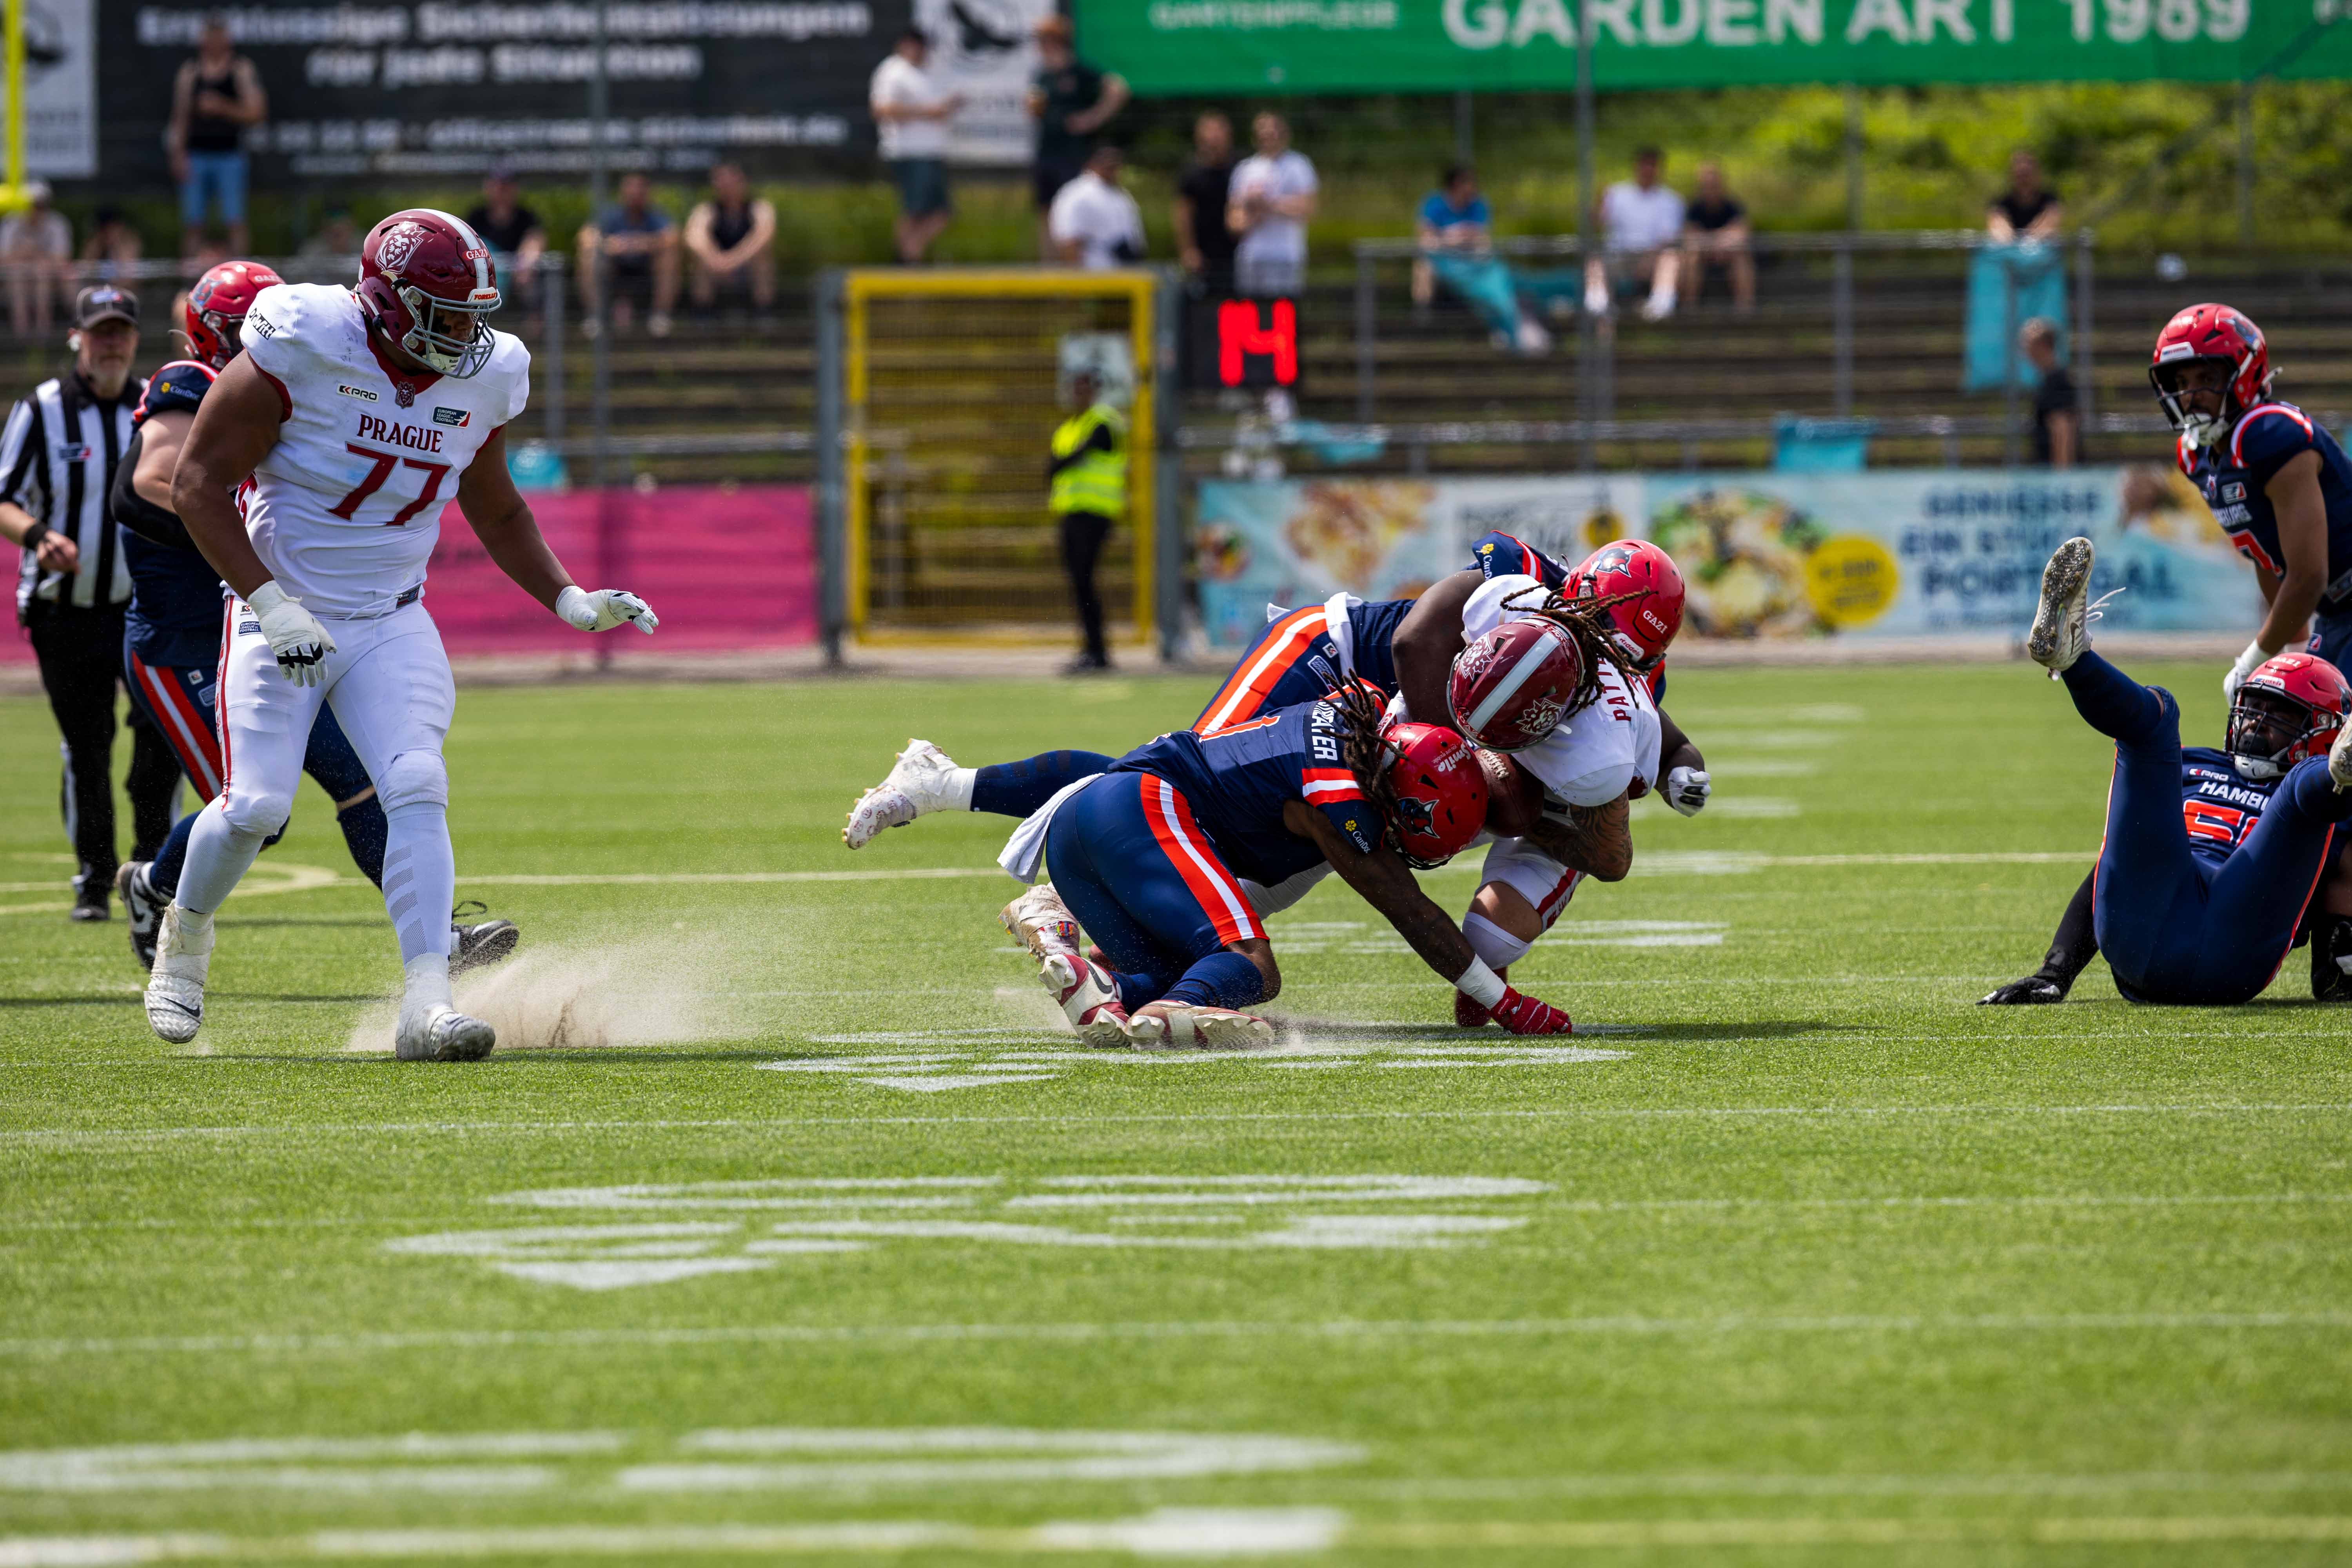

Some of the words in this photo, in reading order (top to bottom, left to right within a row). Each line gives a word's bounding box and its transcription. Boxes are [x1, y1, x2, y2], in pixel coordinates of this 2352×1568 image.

[1443, 0, 1827, 49] GARDEN
[357, 414, 443, 453] PRAGUE
[325, 441, 454, 527] 77
[1643, 610, 1668, 633] GAZI
[1438, 742, 1471, 772] Smile
[1352, 831, 1370, 853] CanDoc
